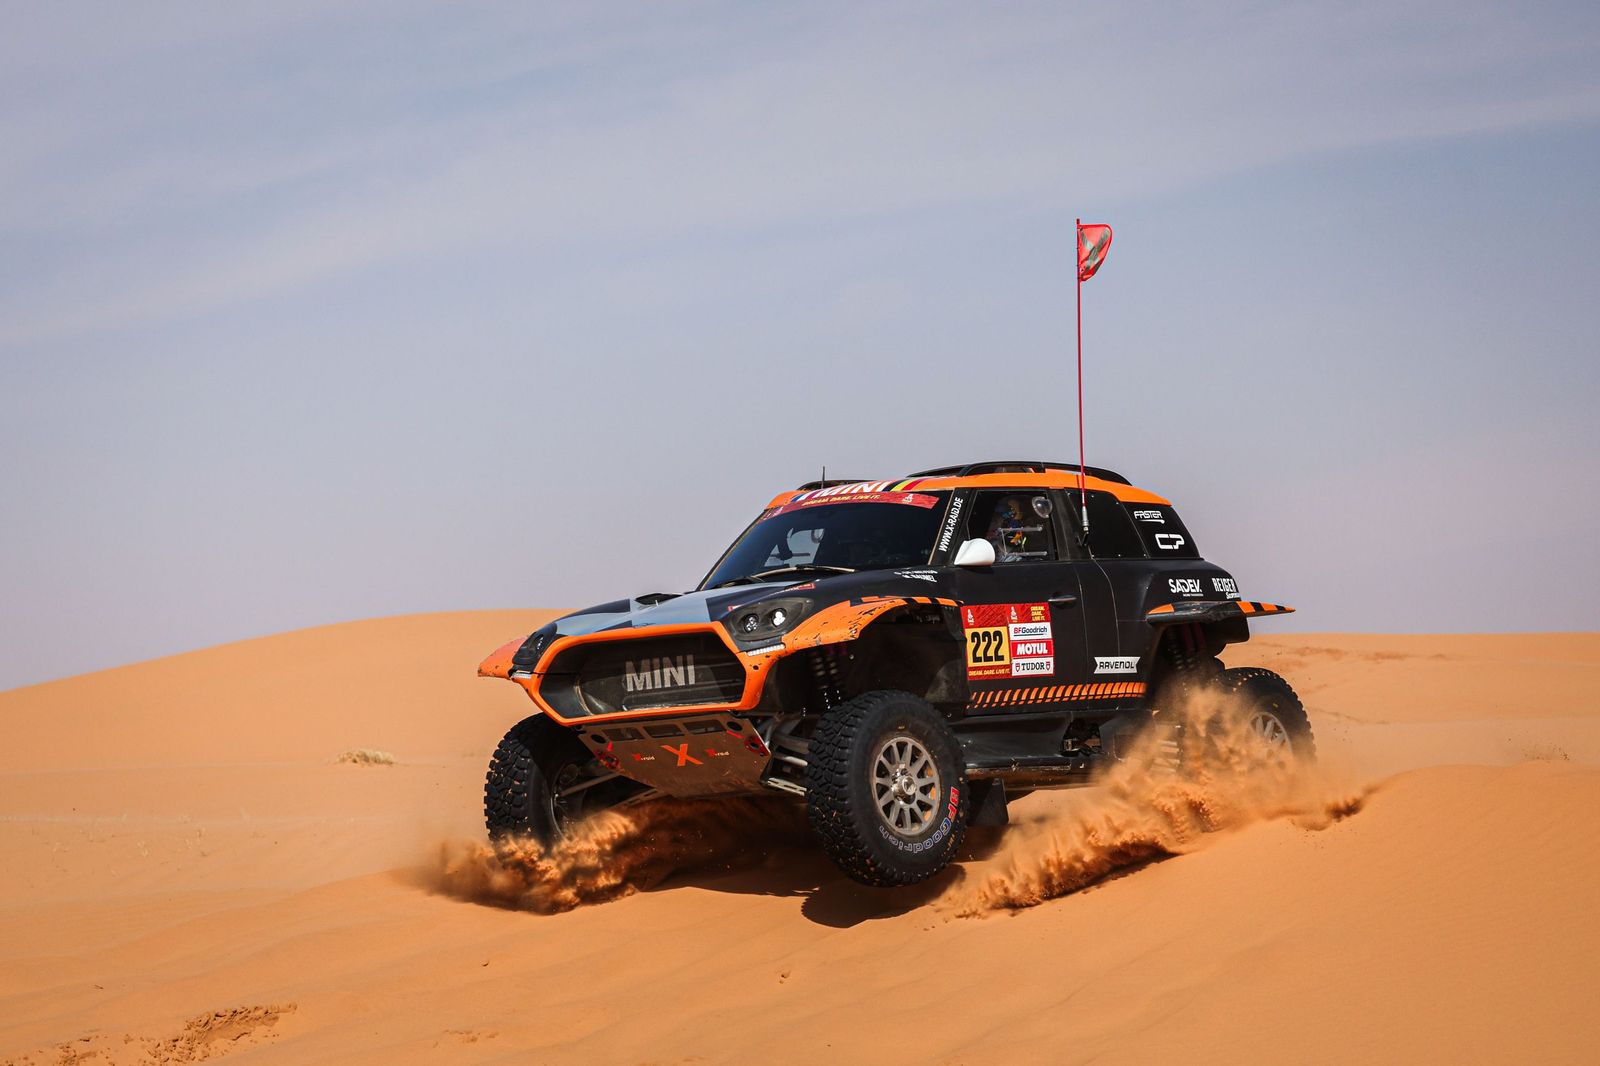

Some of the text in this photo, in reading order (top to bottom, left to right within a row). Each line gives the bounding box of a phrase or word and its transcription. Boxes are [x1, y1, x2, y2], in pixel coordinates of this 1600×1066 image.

[814, 481, 890, 497] MINI
[1211, 577, 1237, 592] REIGER
[1013, 626, 1048, 634] BFGoodrich
[970, 630, 1005, 663] 222
[1016, 642, 1048, 655] MOTUL
[1021, 662, 1045, 671] TUDOR
[1098, 660, 1135, 670] RAVENOL
[624, 654, 696, 692] MINI
[879, 786, 960, 854] BFGoodrich
